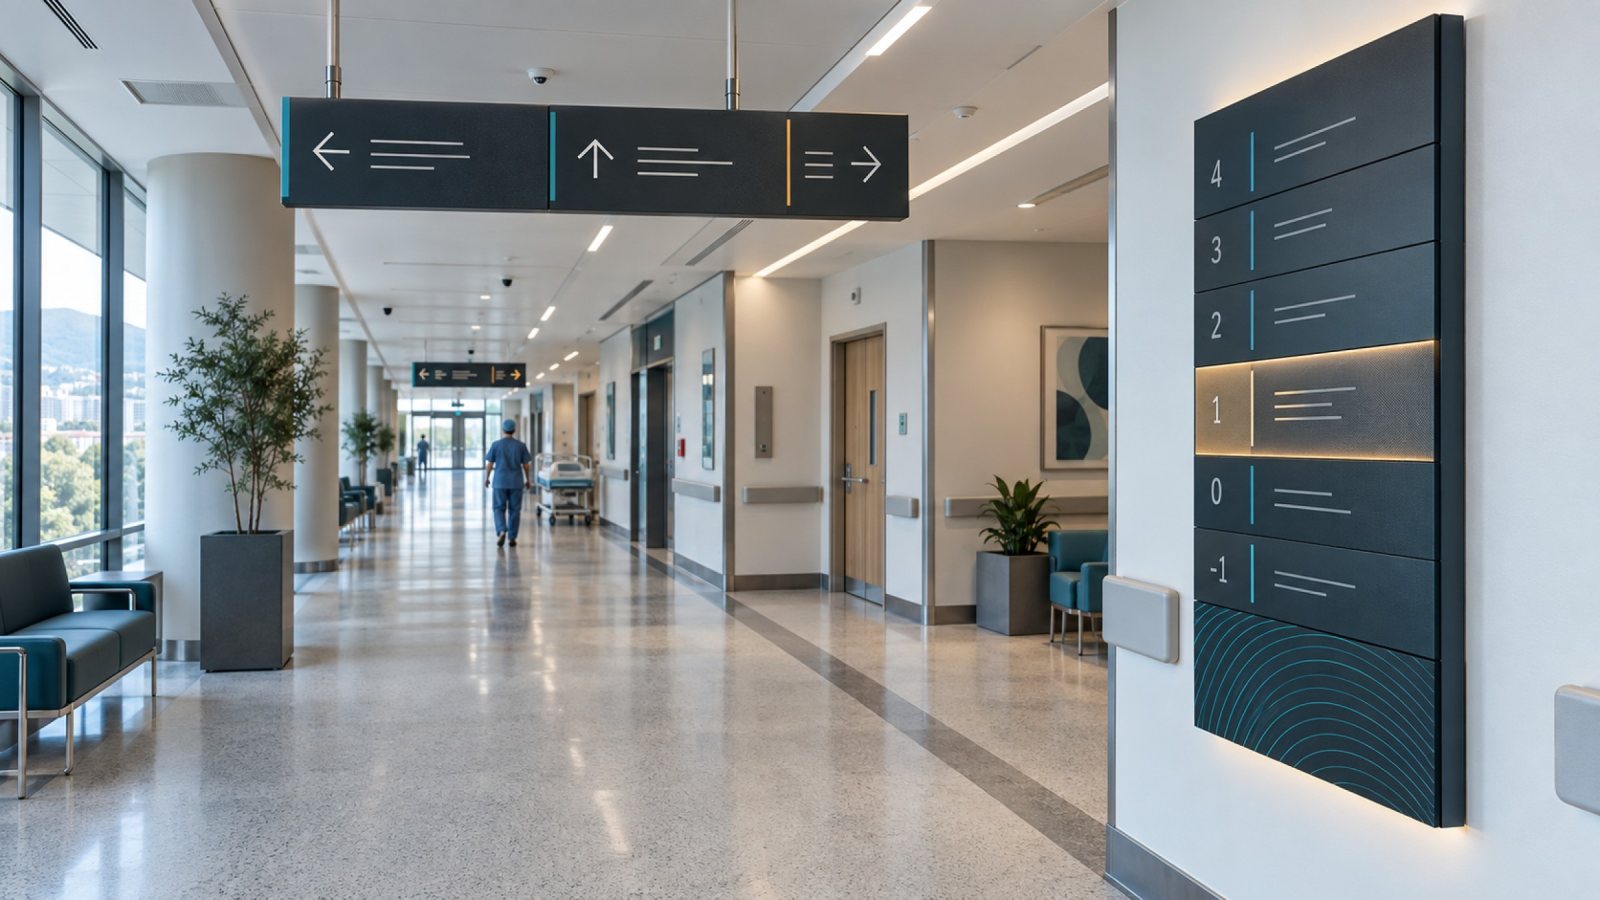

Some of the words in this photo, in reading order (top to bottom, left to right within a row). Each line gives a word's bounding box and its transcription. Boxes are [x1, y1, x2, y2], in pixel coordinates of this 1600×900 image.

[1210, 159, 1223, 188] 4
[1211, 235, 1222, 264] 3
[1211, 311, 1222, 340] 2
[1212, 395, 1221, 424] 1
[1211, 477, 1222, 505] 0
[1210, 555, 1228, 584] -1
